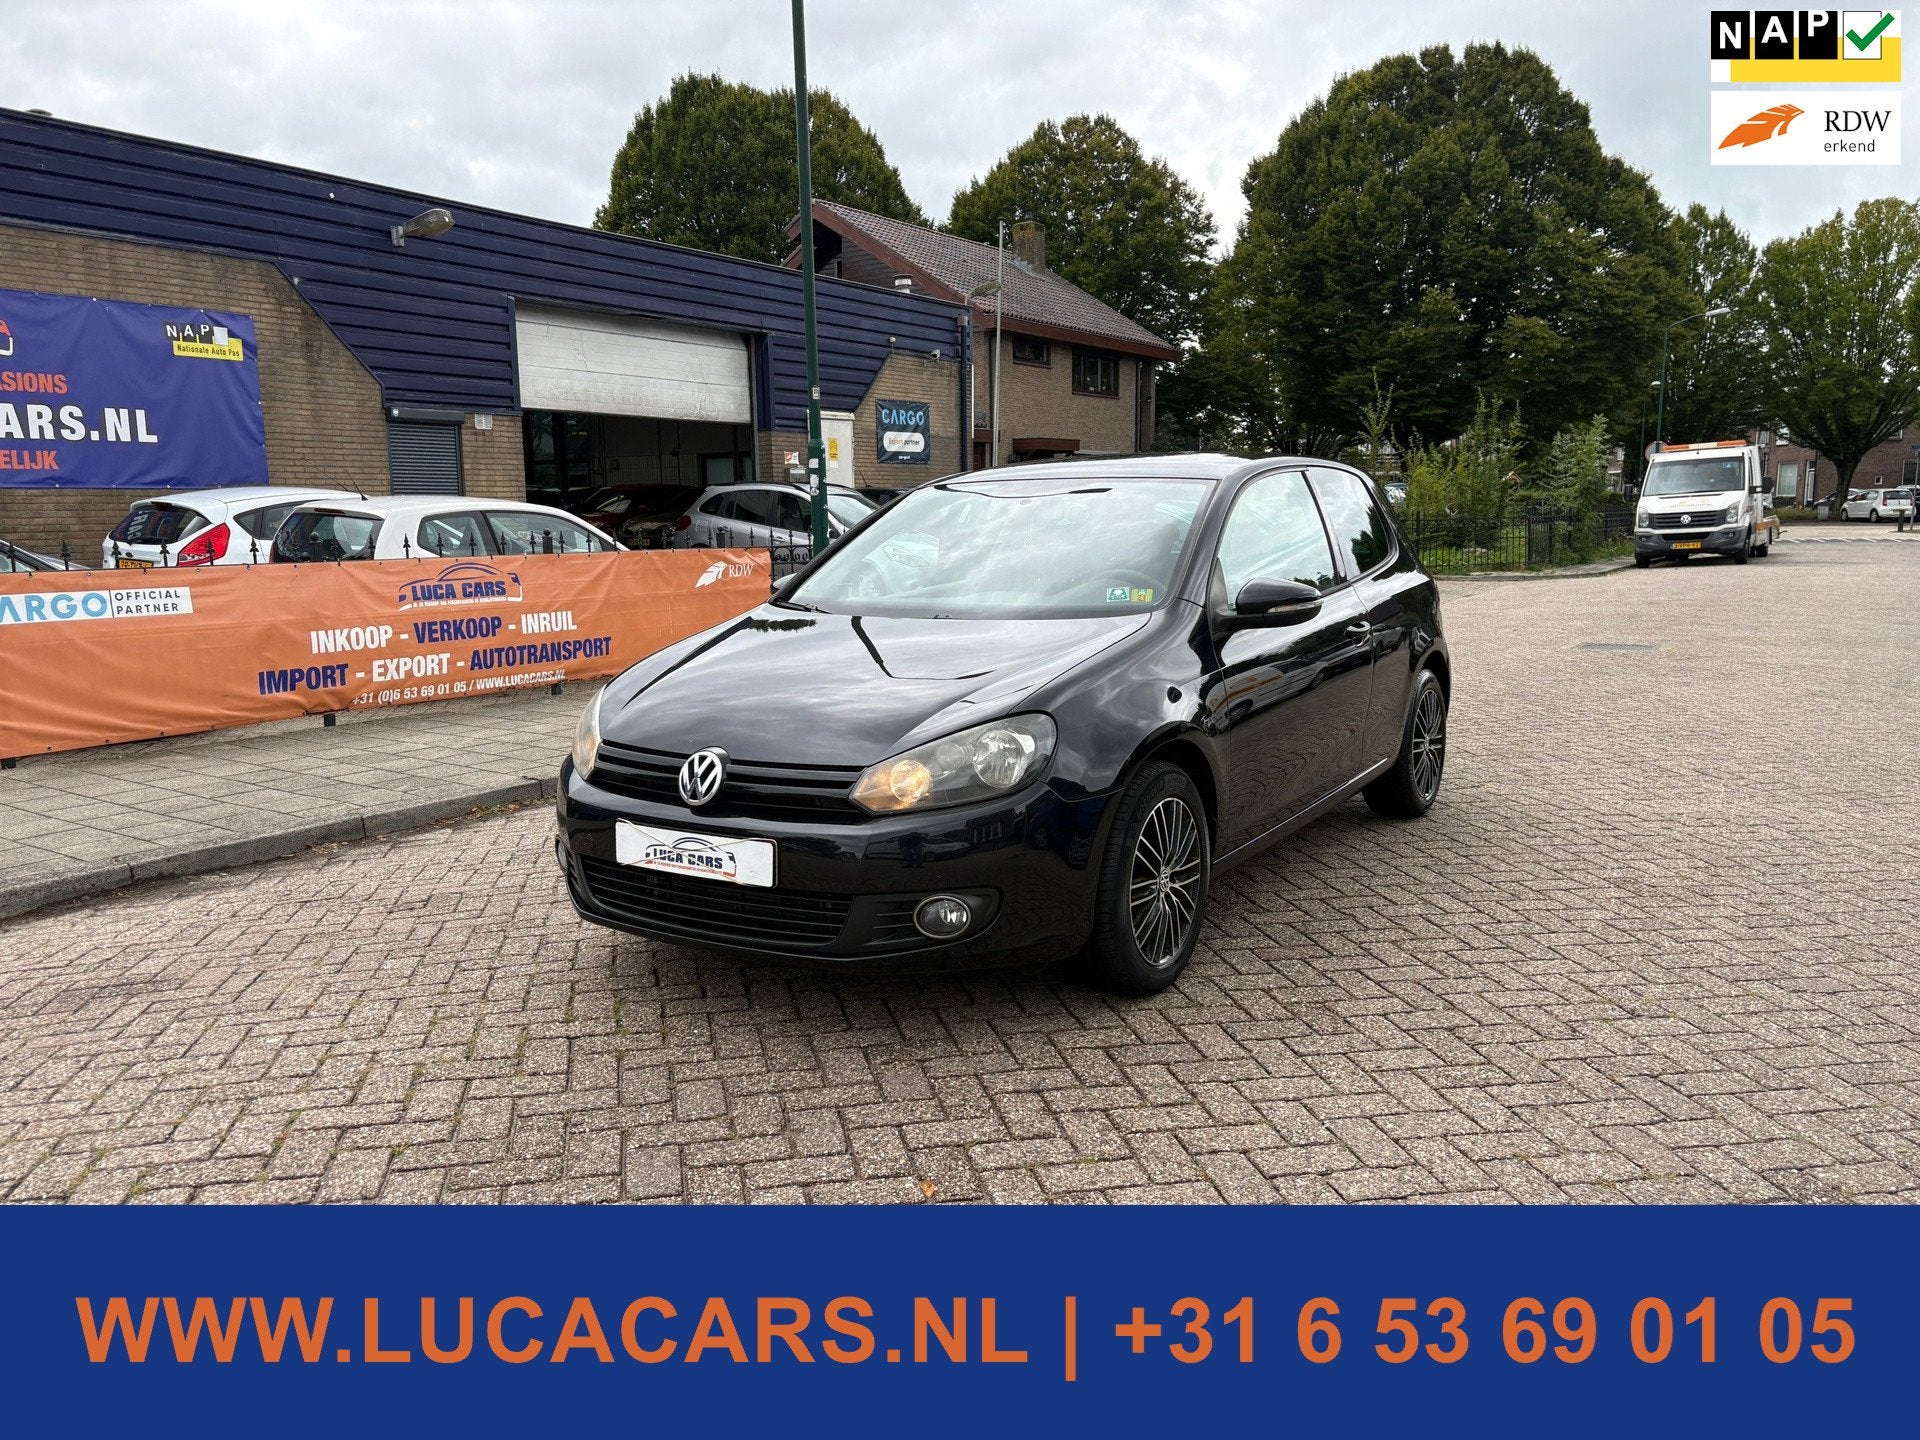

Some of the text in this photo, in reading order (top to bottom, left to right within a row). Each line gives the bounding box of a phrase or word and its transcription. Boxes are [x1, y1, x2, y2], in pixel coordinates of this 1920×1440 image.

[166, 324, 210, 338] NAP
[177, 344, 240, 357] Nationale Auto Pas
[0, 371, 68, 394] SIONS
[0, 402, 158, 443] ARS.NL
[881, 408, 925, 426] CARGO
[0, 450, 59, 470] ELIJK
[728, 563, 754, 577] RDW
[114, 589, 181, 601] OFFICIAL
[411, 580, 507, 602] LUCA CARS
[0, 592, 108, 623] ARGO
[116, 602, 179, 615] PARTNER
[310, 625, 393, 654] INKOOP
[413, 616, 502, 644] VERKOOP
[521, 611, 577, 635] INRUIL
[258, 663, 349, 695] IMPORT
[372, 653, 451, 682] EXPORT
[470, 636, 612, 671] AUTOTRANSPORT
[352, 695, 374, 706] +31
[378, 689, 400, 705] (0)6
[403, 685, 418, 699] 53
[421, 685, 435, 697] 69
[437, 682, 450, 695] 01
[453, 681, 467, 694] 05
[476, 669, 566, 690] WWW.LUCACARS.NL
[687, 853, 723, 870] CARS
